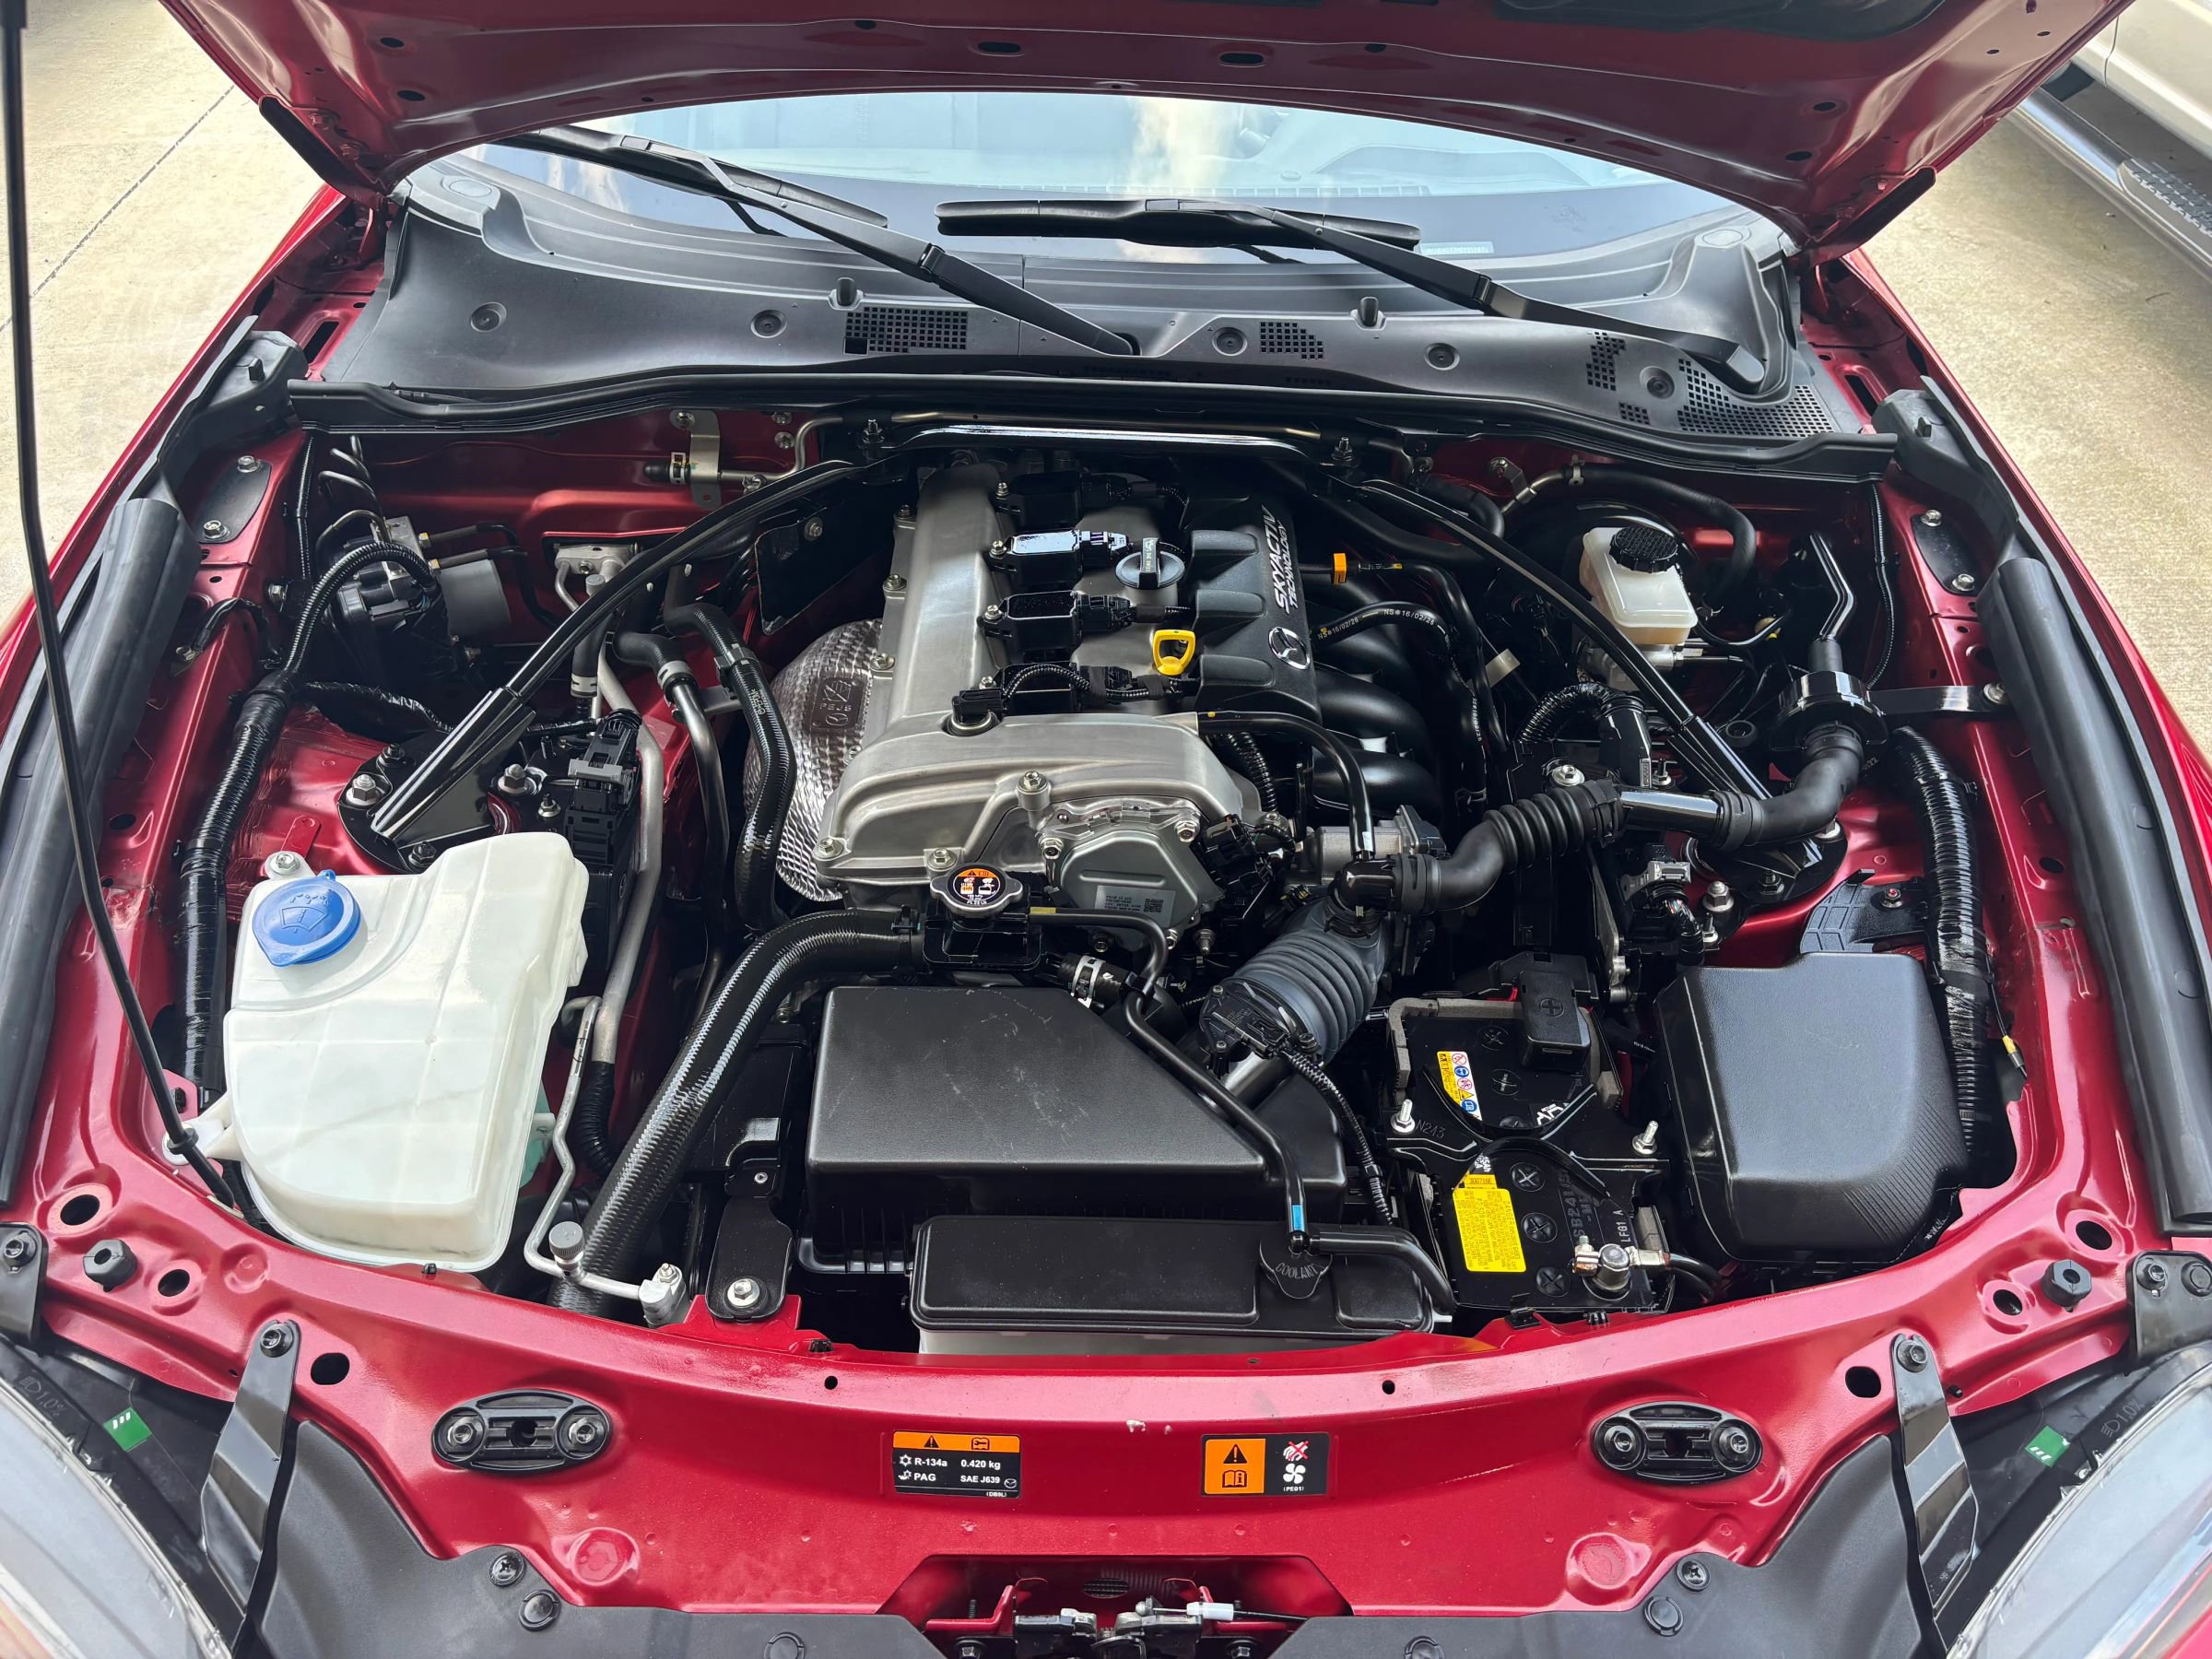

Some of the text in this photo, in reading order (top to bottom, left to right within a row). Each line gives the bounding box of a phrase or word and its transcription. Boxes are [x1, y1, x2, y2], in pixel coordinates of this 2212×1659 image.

[1262, 505, 1289, 614] SKYACTIV
[1277, 519, 1298, 608] TECHNOLOGY
[913, 1473, 936, 1481] PAG
[914, 1457, 1001, 1470] R-134a 0.420 kg
